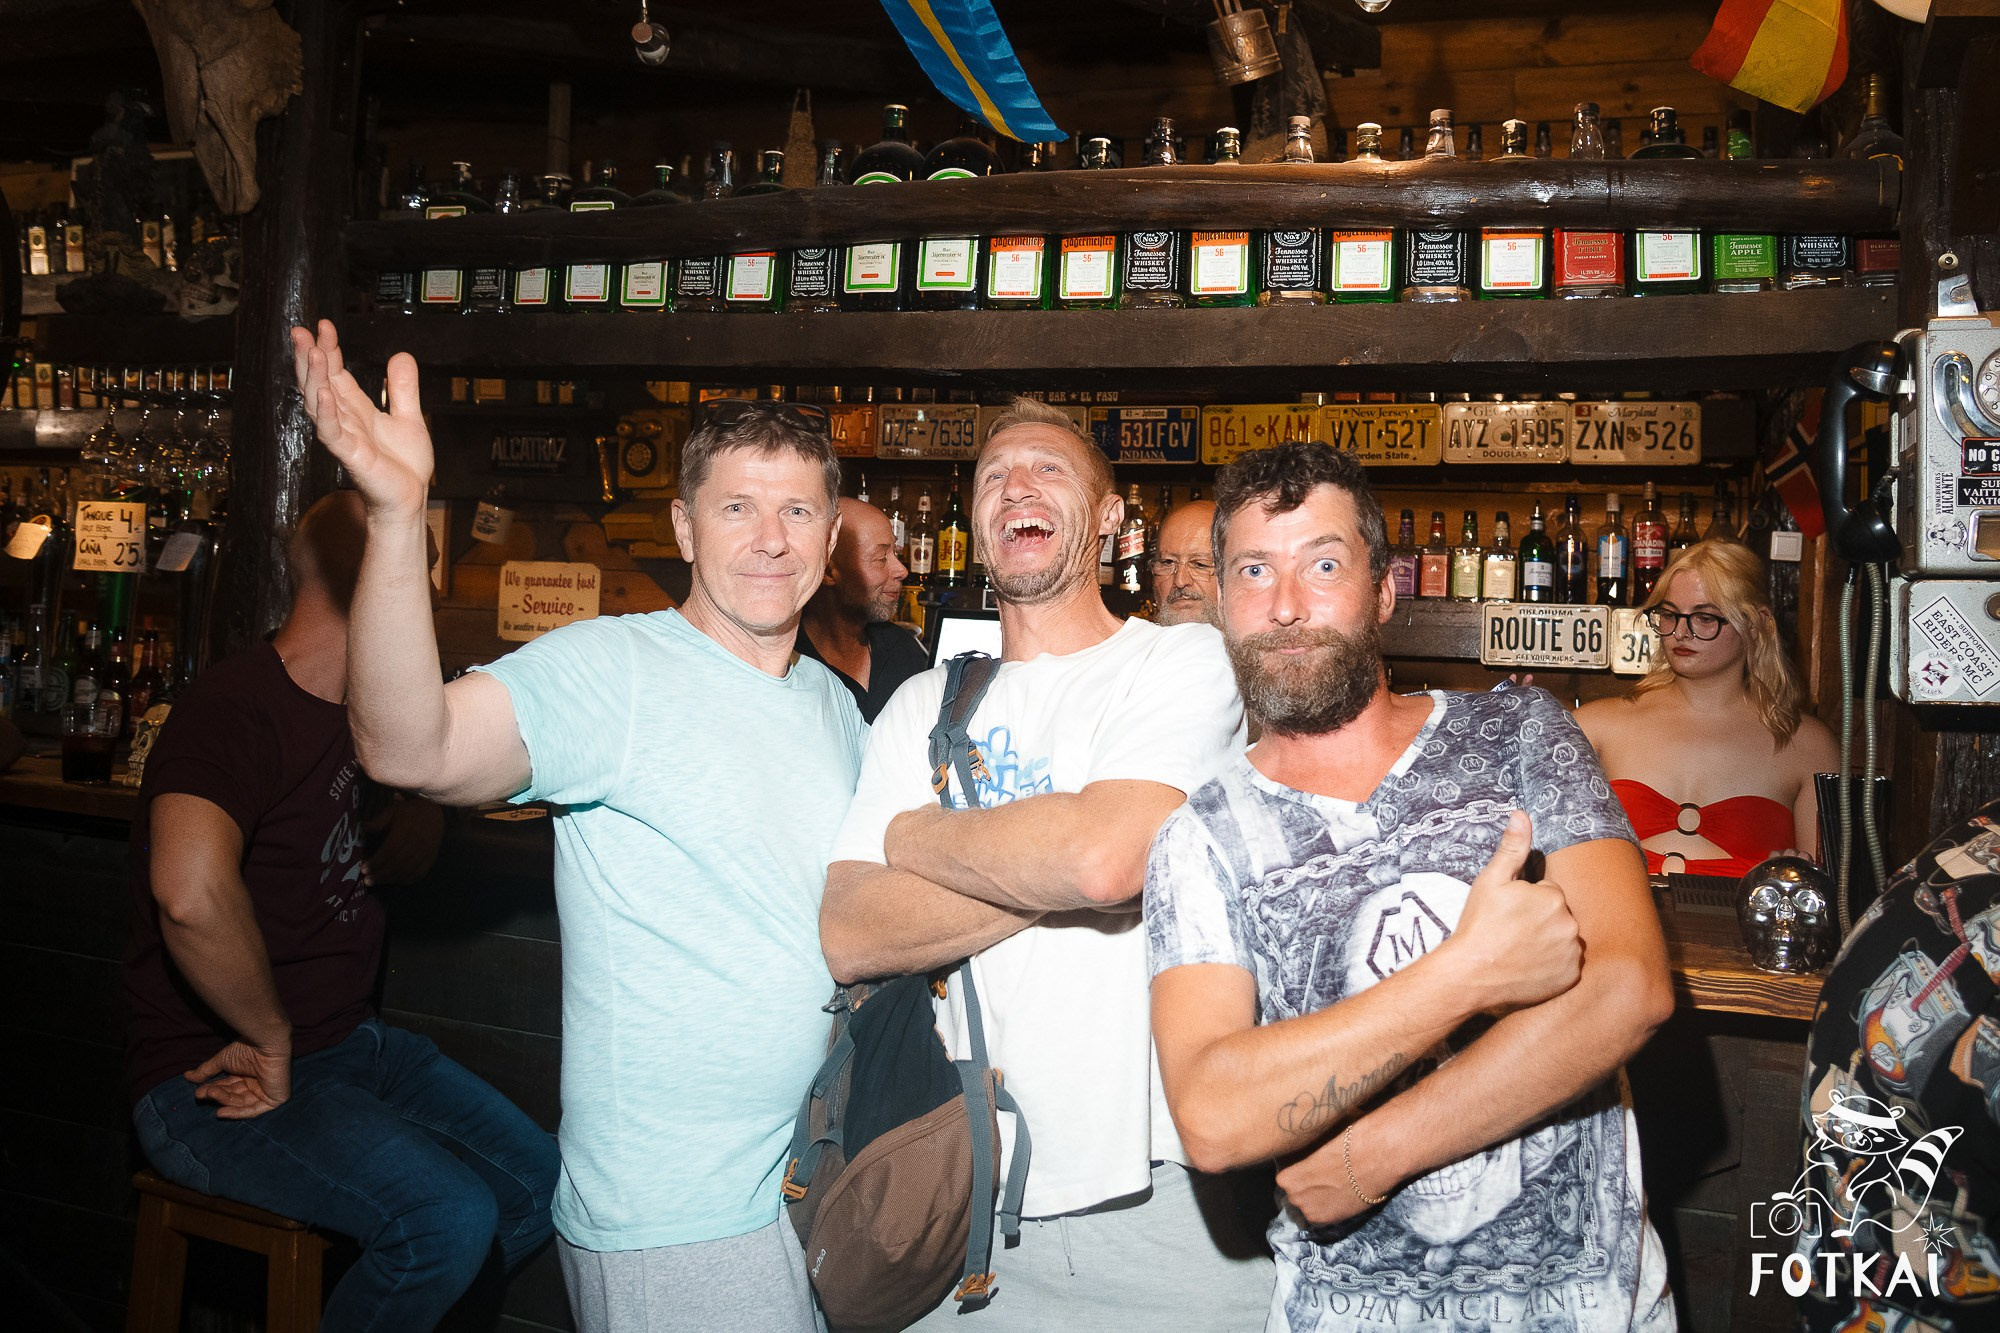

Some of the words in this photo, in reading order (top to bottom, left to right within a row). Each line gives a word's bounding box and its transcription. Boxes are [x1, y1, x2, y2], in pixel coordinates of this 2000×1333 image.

[1662, 233, 1673, 241] 56
[1274, 247, 1309, 255] Tennessee
[1356, 244, 1367, 253] 56
[1418, 242, 1453, 250] Tennessee
[1507, 242, 1517, 251] 56
[1729, 241, 1762, 249] Tennessee
[1011, 253, 1020, 263] 56
[1082, 253, 1092, 263] 56
[1134, 249, 1166, 257] Tennessee
[1215, 248, 1224, 257] 56
[747, 258, 755, 267] 56
[1080, 391, 1092, 402] EL
[1096, 391, 1119, 402] PASO
[1350, 407, 1377, 418] New
[1378, 407, 1411, 420] Jersey
[1581, 406, 1589, 416] 3
[1608, 406, 1658, 420] Maryland
[1120, 422, 1190, 448] 531FCV
[1449, 419, 1489, 448] AYZ
[1511, 419, 1565, 448] 1595
[1576, 421, 1625, 450] ZXN
[1645, 421, 1694, 451] 526
[491, 436, 567, 461] ALCATRAZ
[1482, 450, 1528, 458] DOUGLAS
[1119, 450, 1165, 460] INDIANA
[1385, 451, 1410, 460] State
[1968, 448, 1987, 462] NO
[1941, 472, 1954, 515] ALICANTE
[120, 508, 133, 534] 4
[505, 570, 520, 586] We
[524, 573, 573, 590] guarantee
[577, 572, 596, 590] fast
[522, 594, 574, 615] Service
[1519, 608, 1574, 616] OKLAHOMA
[1490, 616, 1563, 652] ROUTE
[1572, 618, 1602, 653] 66
[1958, 623, 1987, 654] SUPPORT
[1931, 610, 1961, 640] EAST
[1958, 640, 1995, 678] COAST
[1922, 618, 1964, 662] RIDERS
[1962, 664, 1982, 684] MC
[329, 764, 354, 800] STATE
[1303, 1284, 1399, 1325] JOHN
[1417, 1280, 1599, 1324] MCLANE
